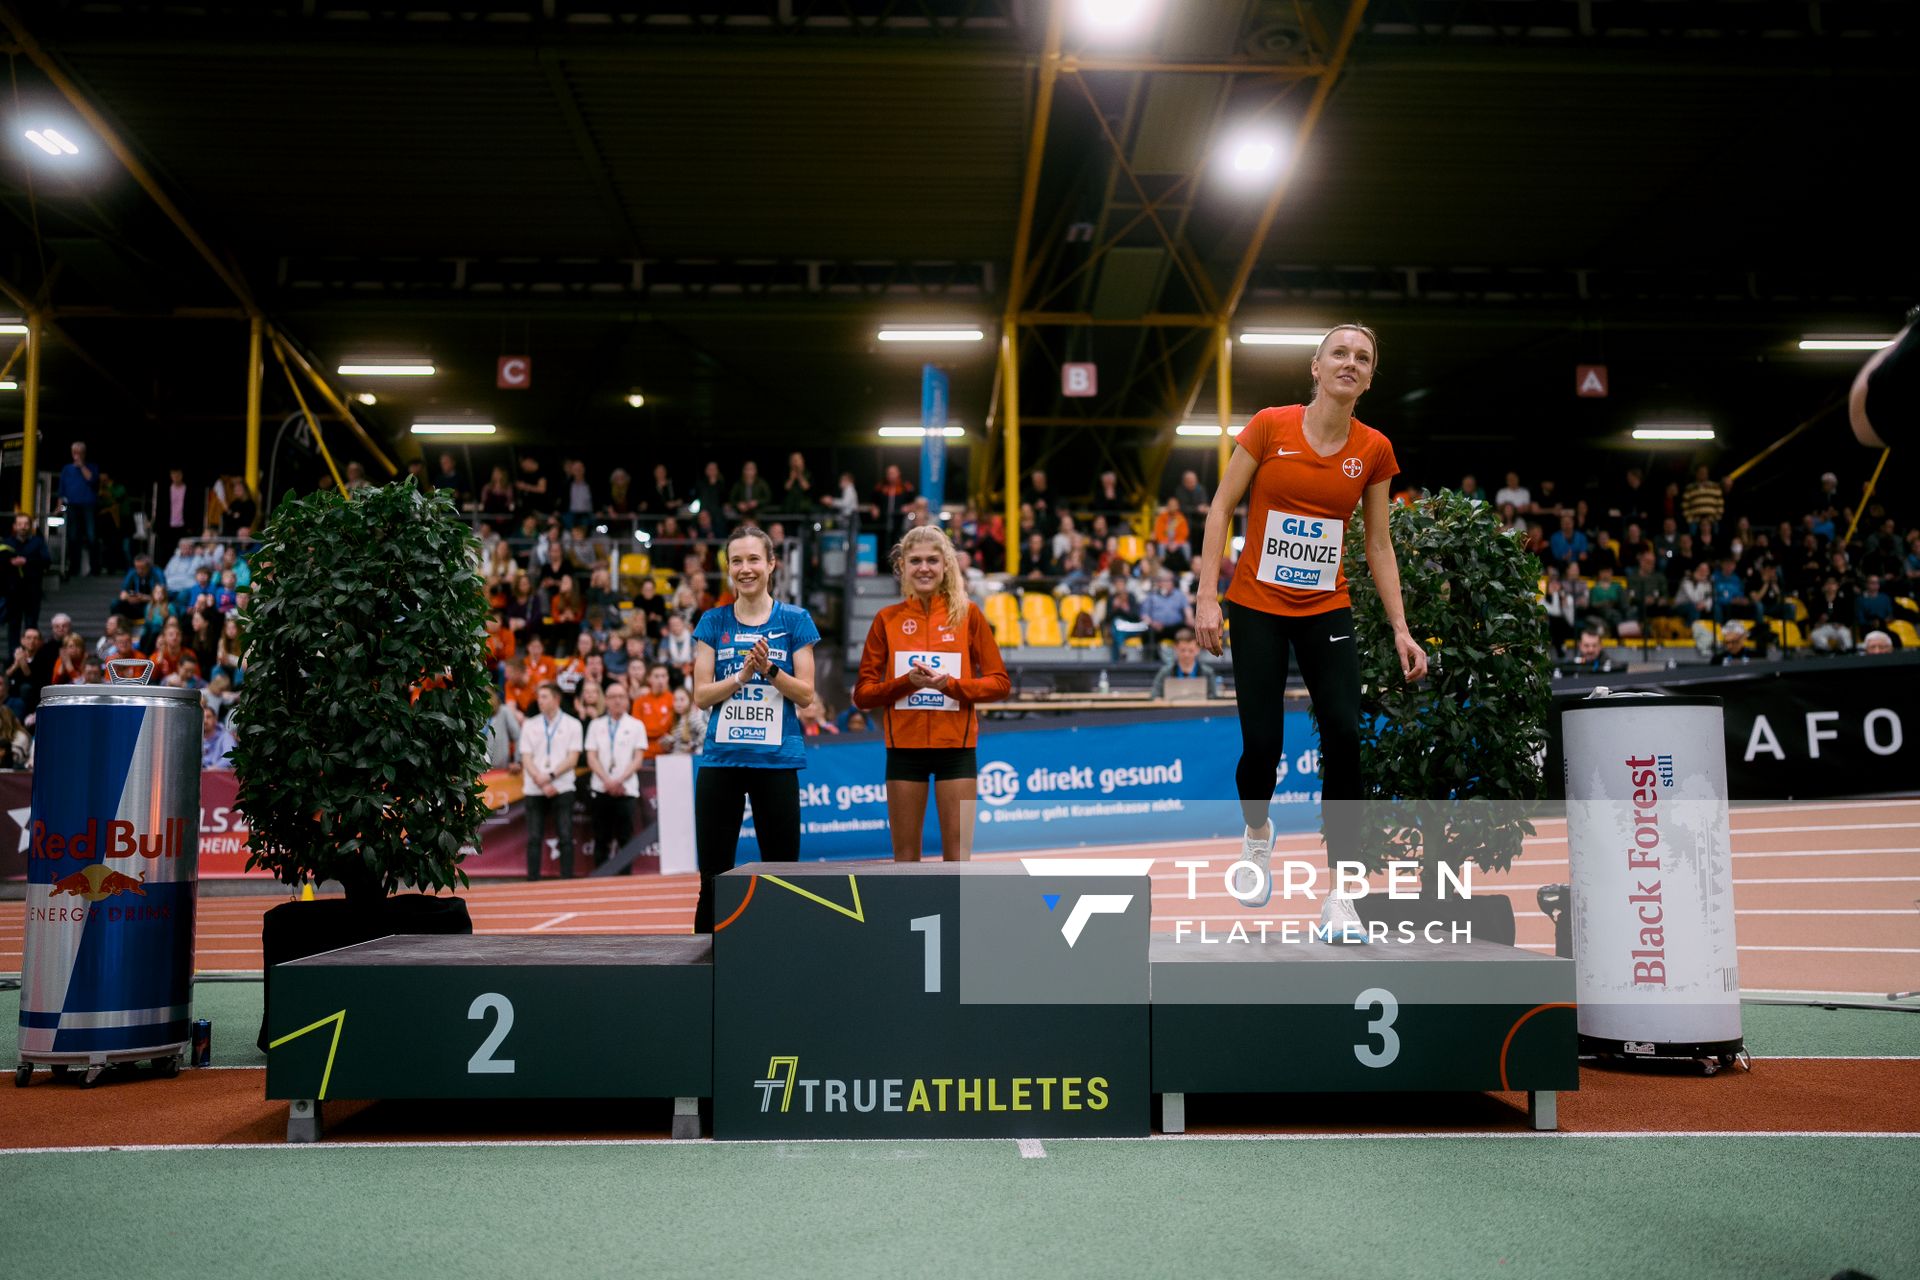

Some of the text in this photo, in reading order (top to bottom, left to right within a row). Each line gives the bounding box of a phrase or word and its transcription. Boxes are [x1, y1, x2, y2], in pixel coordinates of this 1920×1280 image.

[503, 360, 525, 384] C
[1068, 367, 1089, 391] B
[1582, 369, 1604, 392] A
[1266, 537, 1338, 564] BRONZE
[1293, 571, 1319, 581] PLAN
[724, 705, 774, 721] SILBER
[743, 728, 765, 737] PLAN
[977, 771, 1020, 796] BIG
[1026, 758, 1184, 794] direkt gesund
[1658, 753, 1673, 788] still
[31, 817, 97, 860] Red
[105, 817, 185, 859] Bull
[1625, 753, 1667, 987] Black Forest
[30, 903, 171, 923] ENERGY DRINK
[911, 914, 941, 993] 1
[467, 992, 516, 1074] 2
[1353, 987, 1401, 1069] 3
